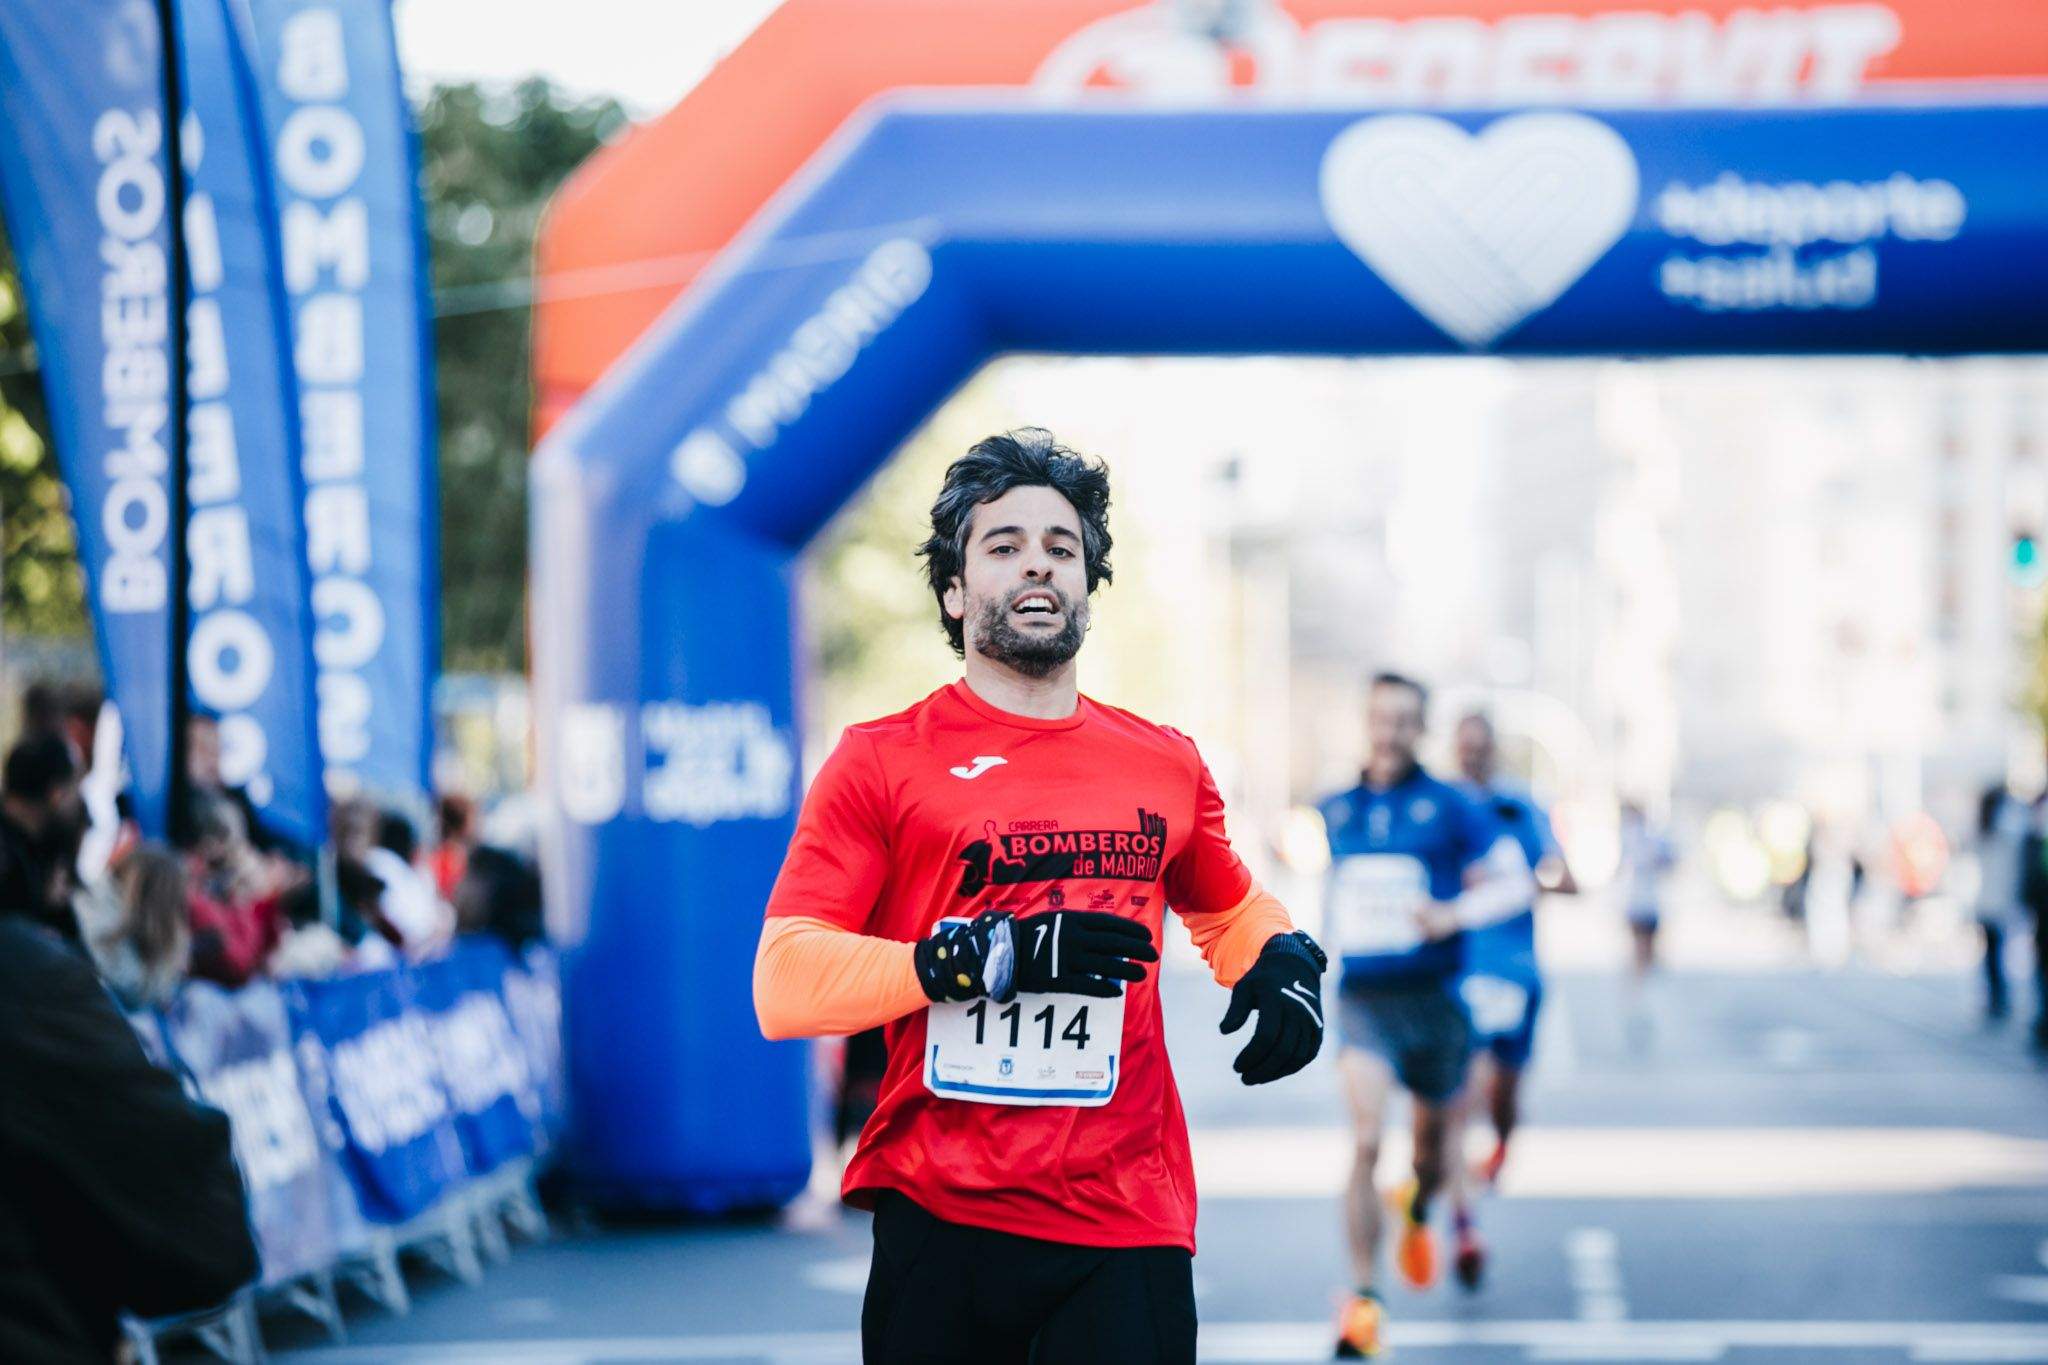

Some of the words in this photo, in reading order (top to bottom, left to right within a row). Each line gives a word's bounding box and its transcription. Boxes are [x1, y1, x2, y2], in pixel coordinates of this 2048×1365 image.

[1009, 819, 1059, 832] CARRERA
[1011, 832, 1161, 857] BOMBEROS
[1073, 852, 1095, 876] de
[1101, 852, 1158, 879] MADRID
[966, 999, 1091, 1050] 1114
